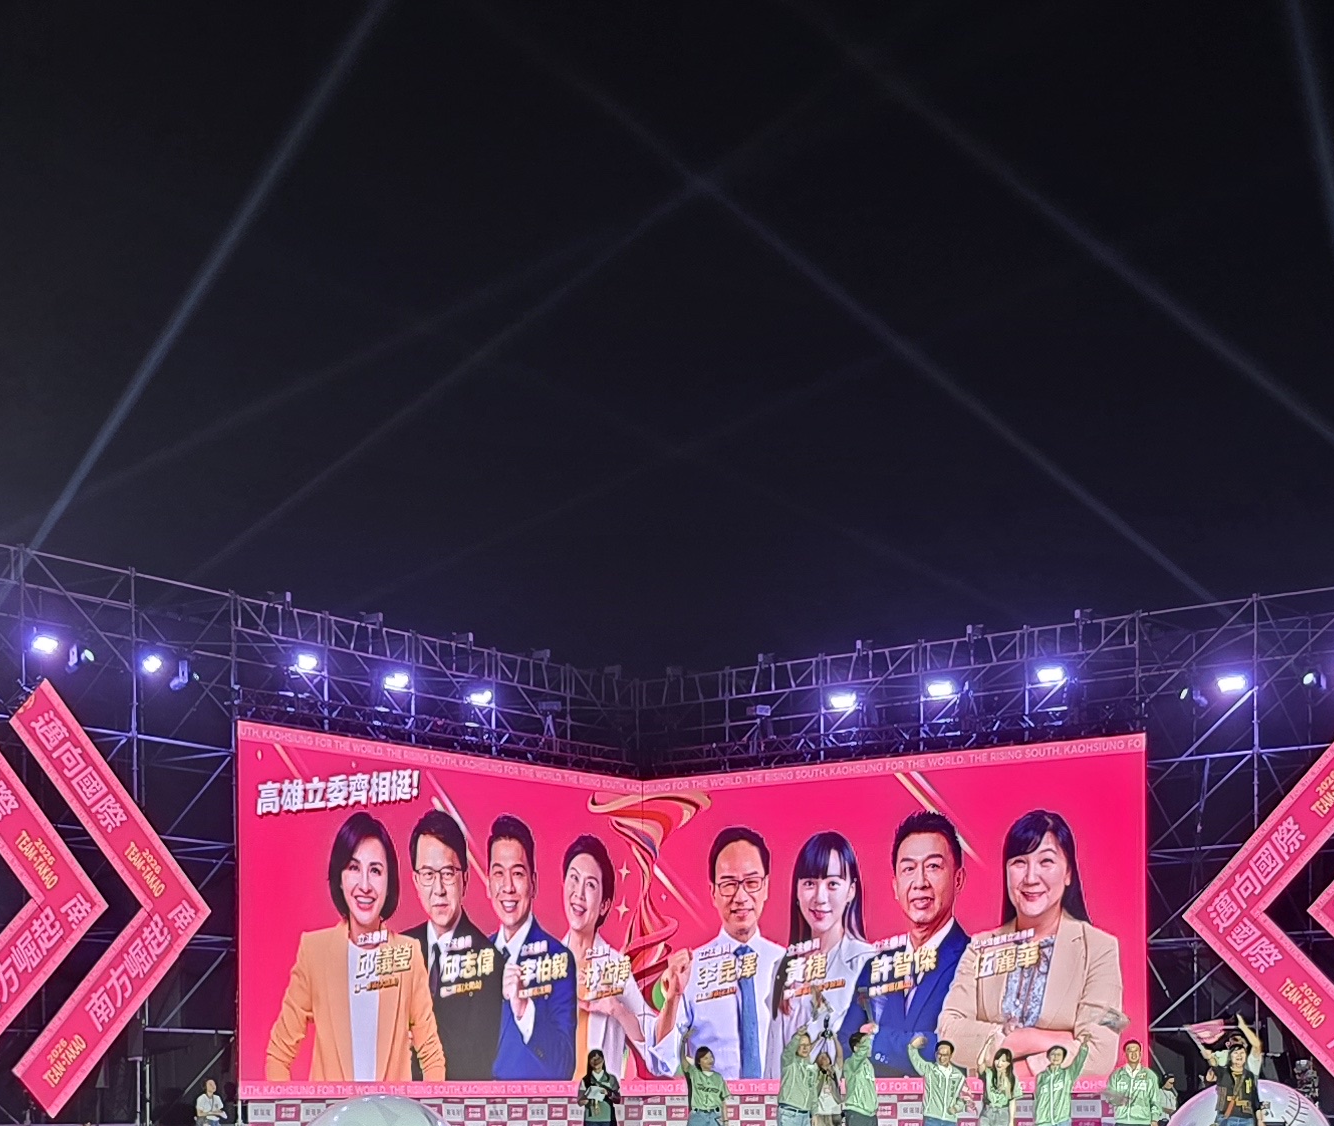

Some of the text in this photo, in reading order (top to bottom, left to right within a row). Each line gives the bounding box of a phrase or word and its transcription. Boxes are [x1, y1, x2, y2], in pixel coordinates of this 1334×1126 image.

[29, 710, 129, 834] 邁向國際
[262, 730, 306, 746] KAOHSIUNG
[310, 737, 331, 749] FOR
[334, 741, 350, 752] THE
[353, 743, 382, 757] WORLD.
[386, 748, 401, 760] THE
[504, 765, 519, 776] FOR
[520, 767, 532, 778] THE
[564, 773, 577, 784] THE
[672, 780, 687, 790] FOR
[691, 778, 706, 789] THE
[745, 774, 762, 784] THE
[764, 771, 793, 783] RISING
[829, 762, 882, 776] KAOHSIUNG
[885, 760, 903, 771] FOR
[906, 758, 923, 769] THE
[927, 755, 964, 767] WORLD.
[969, 752, 986, 763] THE
[990, 749, 1021, 761] RISING
[1063, 740, 1124, 754] KAOHSIUNG
[256, 769, 419, 816] 高雄立委齊相挺!
[15, 829, 58, 891] TEAM TAKAO
[34, 836, 57, 865] 2026
[142, 847, 163, 874] 2026
[124, 840, 166, 899] TEAM TAKAO
[1206, 814, 1308, 934] 邁向國際
[356, 945, 413, 979] 邱議瑩
[976, 943, 1040, 979] 伍麗華
[1225, 916, 1284, 975] 國際
[85, 913, 172, 1033] 南方崛起
[440, 948, 494, 983] 邱志偉
[520, 952, 568, 987] 李柏毅
[784, 953, 827, 986] 黃捷
[870, 947, 937, 984] 許智傑
[1278, 977, 1326, 1031] TEAM TAKAO
[1298, 981, 1321, 1007] 2026
[42, 1033, 87, 1088] TEAM TAKAO
[47, 1036, 69, 1066] 2026
[263, 1085, 315, 1095] KAOHSIUNG
[317, 1085, 334, 1095] FOR
[337, 1085, 353, 1095] THE
[389, 1085, 404, 1095] THE
[406, 1085, 432, 1095] RISING
[463, 1084, 506, 1094] KAOHSIUNG
[507, 1084, 521, 1094] FOR
[522, 1084, 537, 1094] THE
[567, 1083, 577, 1093] TH
[749, 1081, 764, 1091] THE
[889, 1082, 907, 1091] FOR
[910, 1082, 922, 1091] TH
